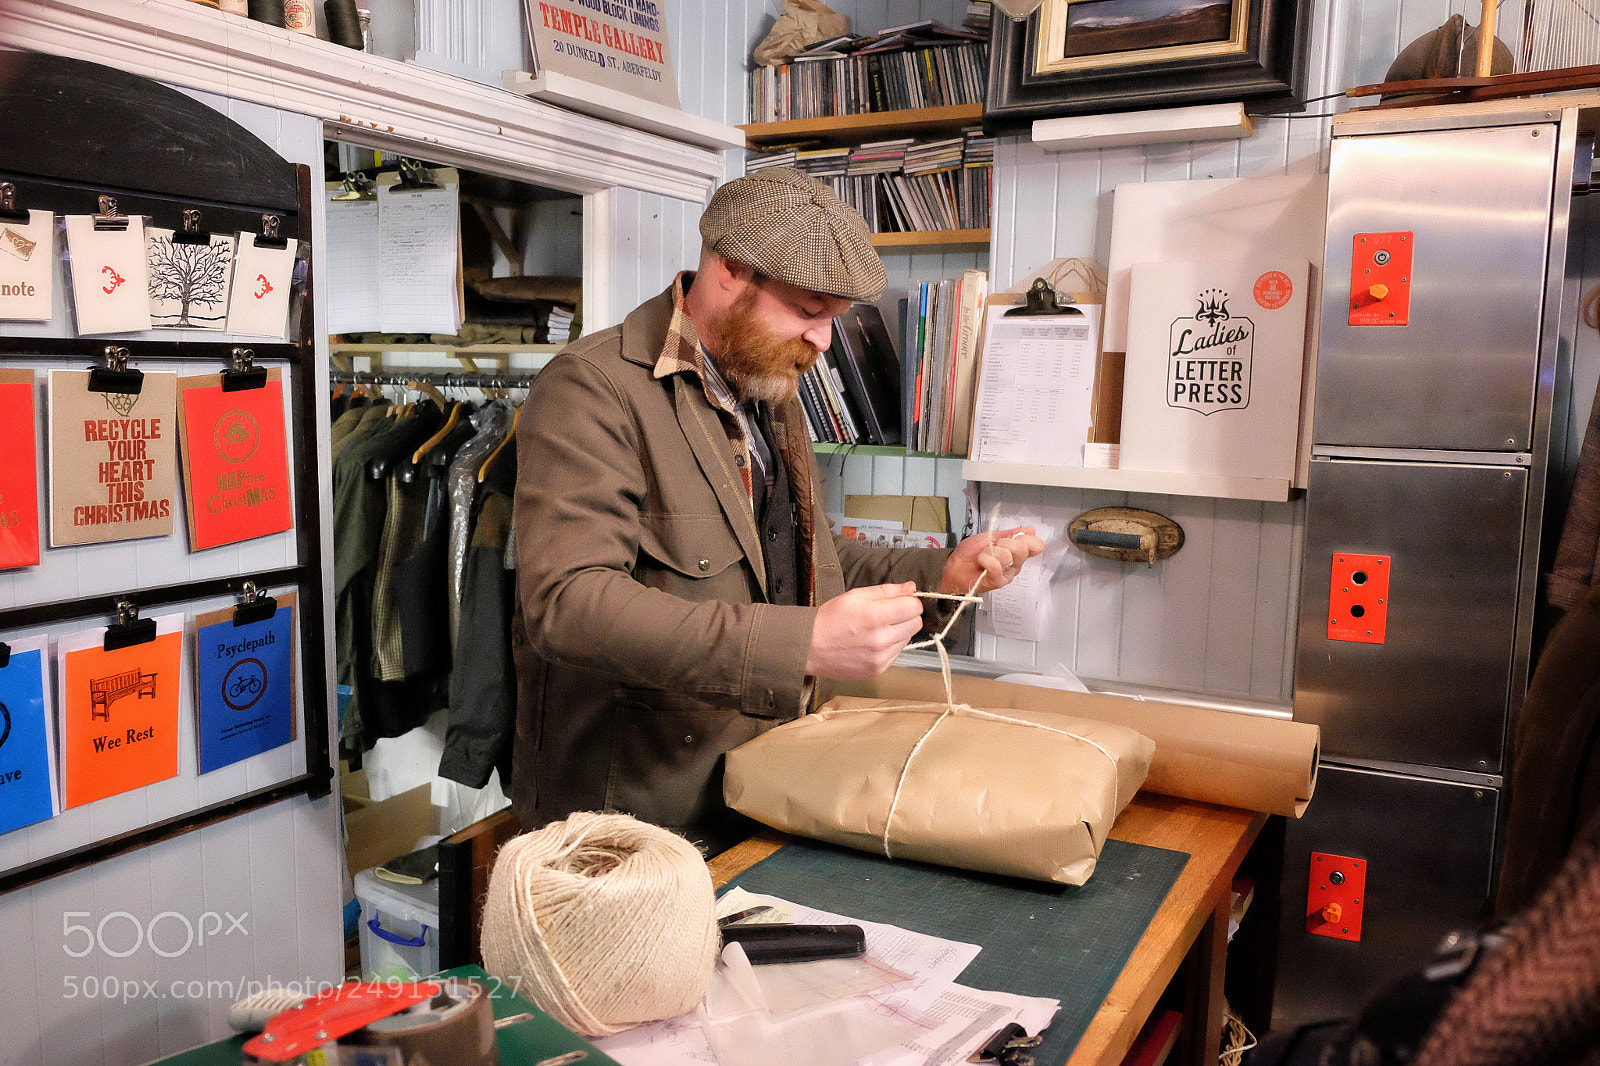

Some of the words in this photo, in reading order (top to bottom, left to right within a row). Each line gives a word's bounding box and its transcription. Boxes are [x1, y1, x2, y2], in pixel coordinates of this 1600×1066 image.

[602, 0, 628, 22] BLOCK
[629, 9, 660, 33] LININGS
[539, 1, 602, 45] TEMPLE
[602, 23, 664, 64] GALLERY
[553, 39, 565, 52] 20
[566, 42, 606, 67] DUNKELD
[622, 61, 662, 82] ABERFELDY
[1, 280, 35, 297] note
[1172, 322, 1249, 356] Ladies
[1226, 344, 1237, 356] of
[1175, 360, 1243, 382] LETTER
[1173, 383, 1243, 404] PRESS
[84, 418, 161, 442] RECYCLE
[107, 438, 147, 461] YOUR
[98, 459, 155, 483] HEART
[106, 481, 145, 504] THIS
[207, 485, 276, 513] ChristMAS
[73, 498, 170, 527] CHRISTMAS
[216, 630, 276, 659] Psyclepath
[91, 735, 122, 754] Wee
[125, 725, 155, 745] Rest
